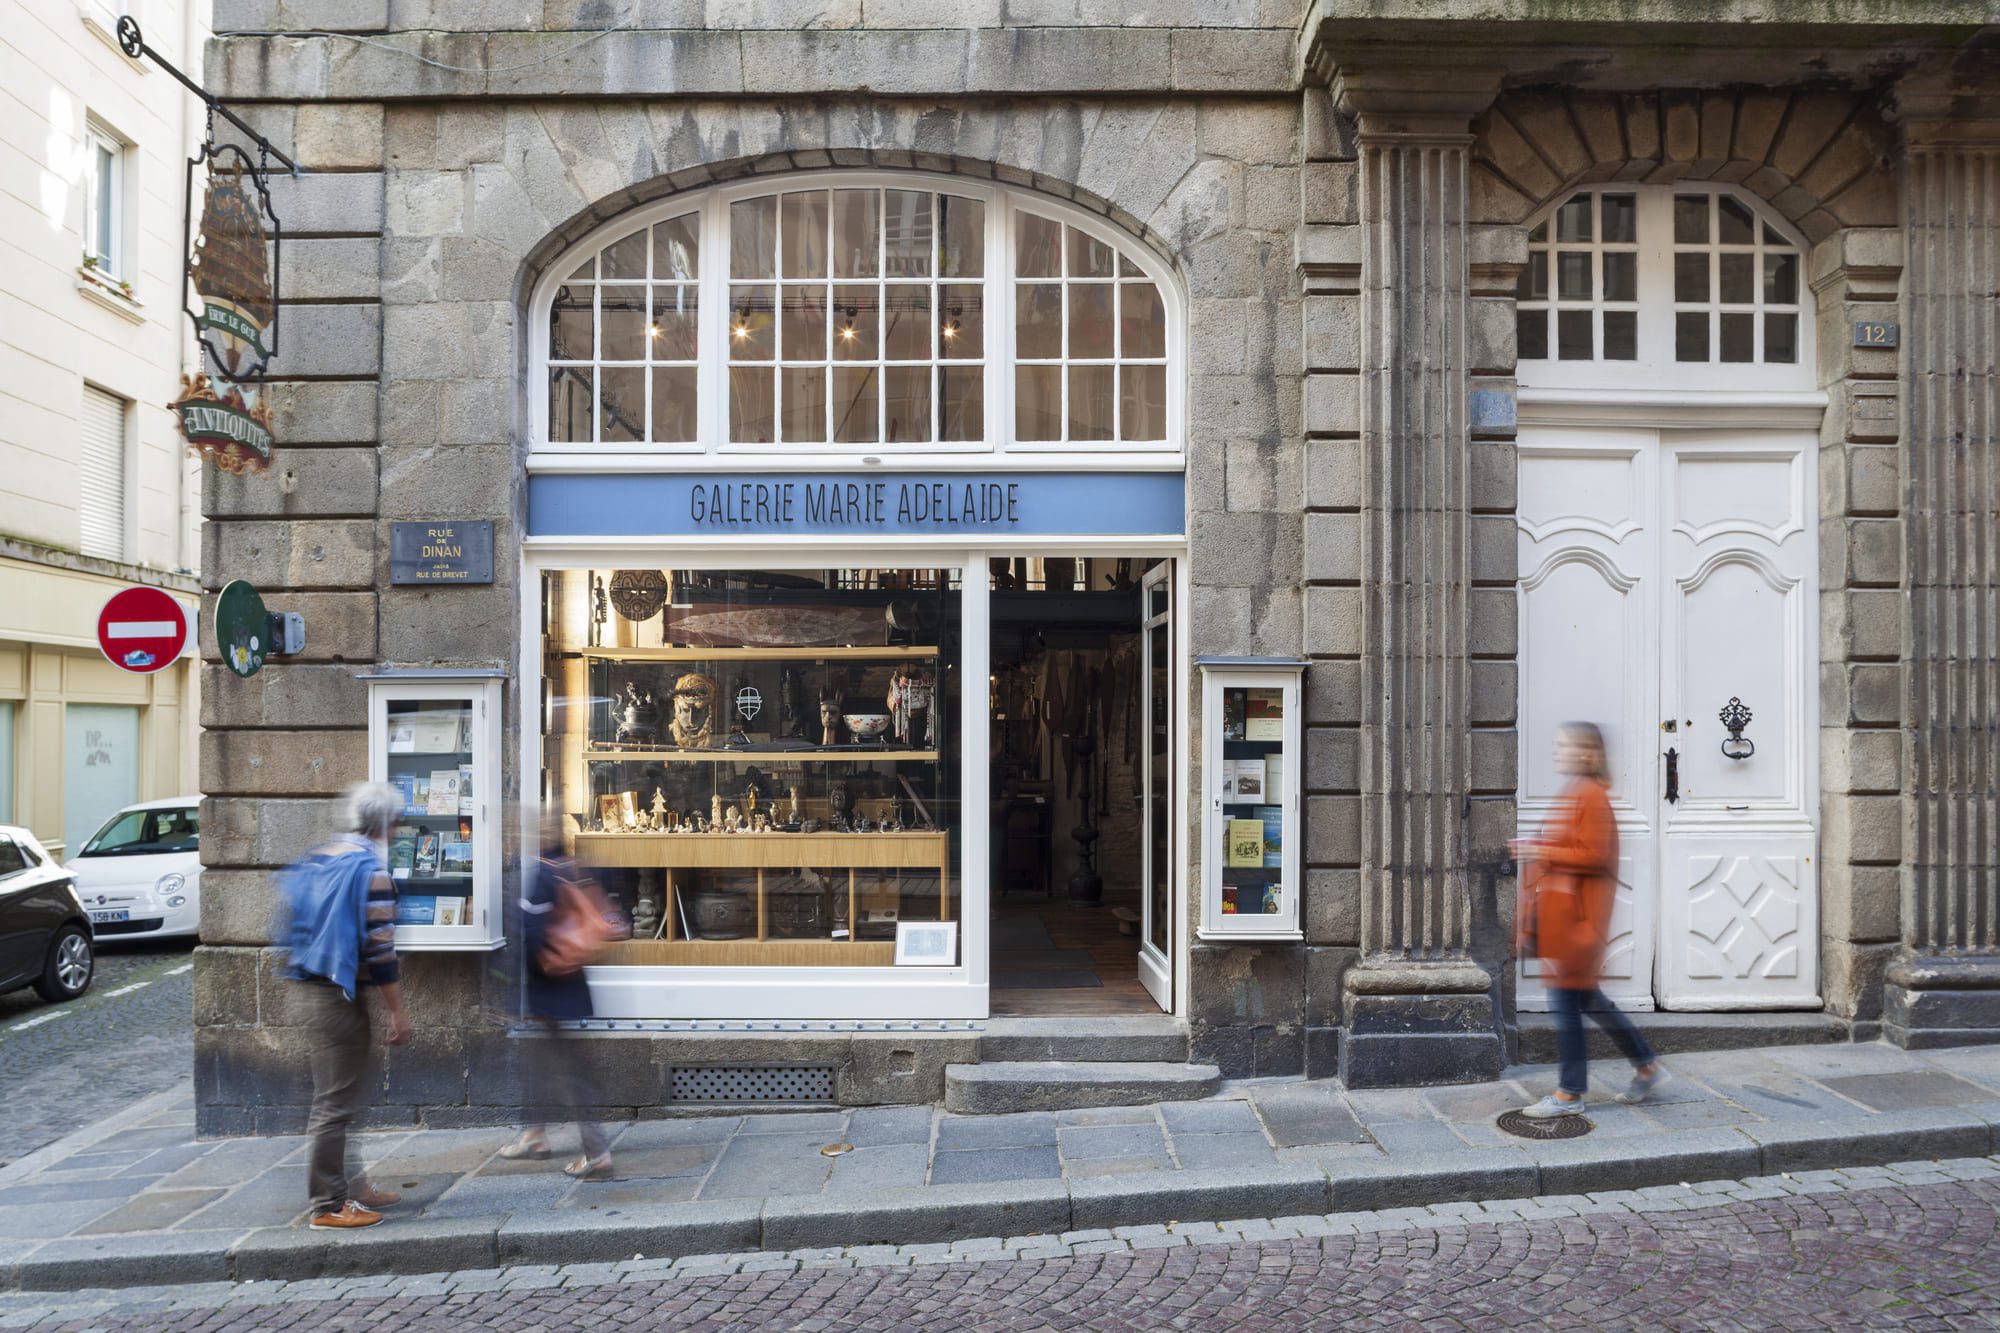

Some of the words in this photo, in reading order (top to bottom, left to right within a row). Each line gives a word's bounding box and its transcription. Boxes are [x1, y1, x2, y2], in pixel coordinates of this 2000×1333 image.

[228, 315, 239, 330] LE
[1864, 325, 1886, 343] 12
[691, 483, 795, 523] GALERIE
[805, 483, 886, 523] MARIE
[897, 483, 1020, 523] ADELAIDE
[428, 528, 454, 537] RUE
[422, 545, 461, 558] DINAN
